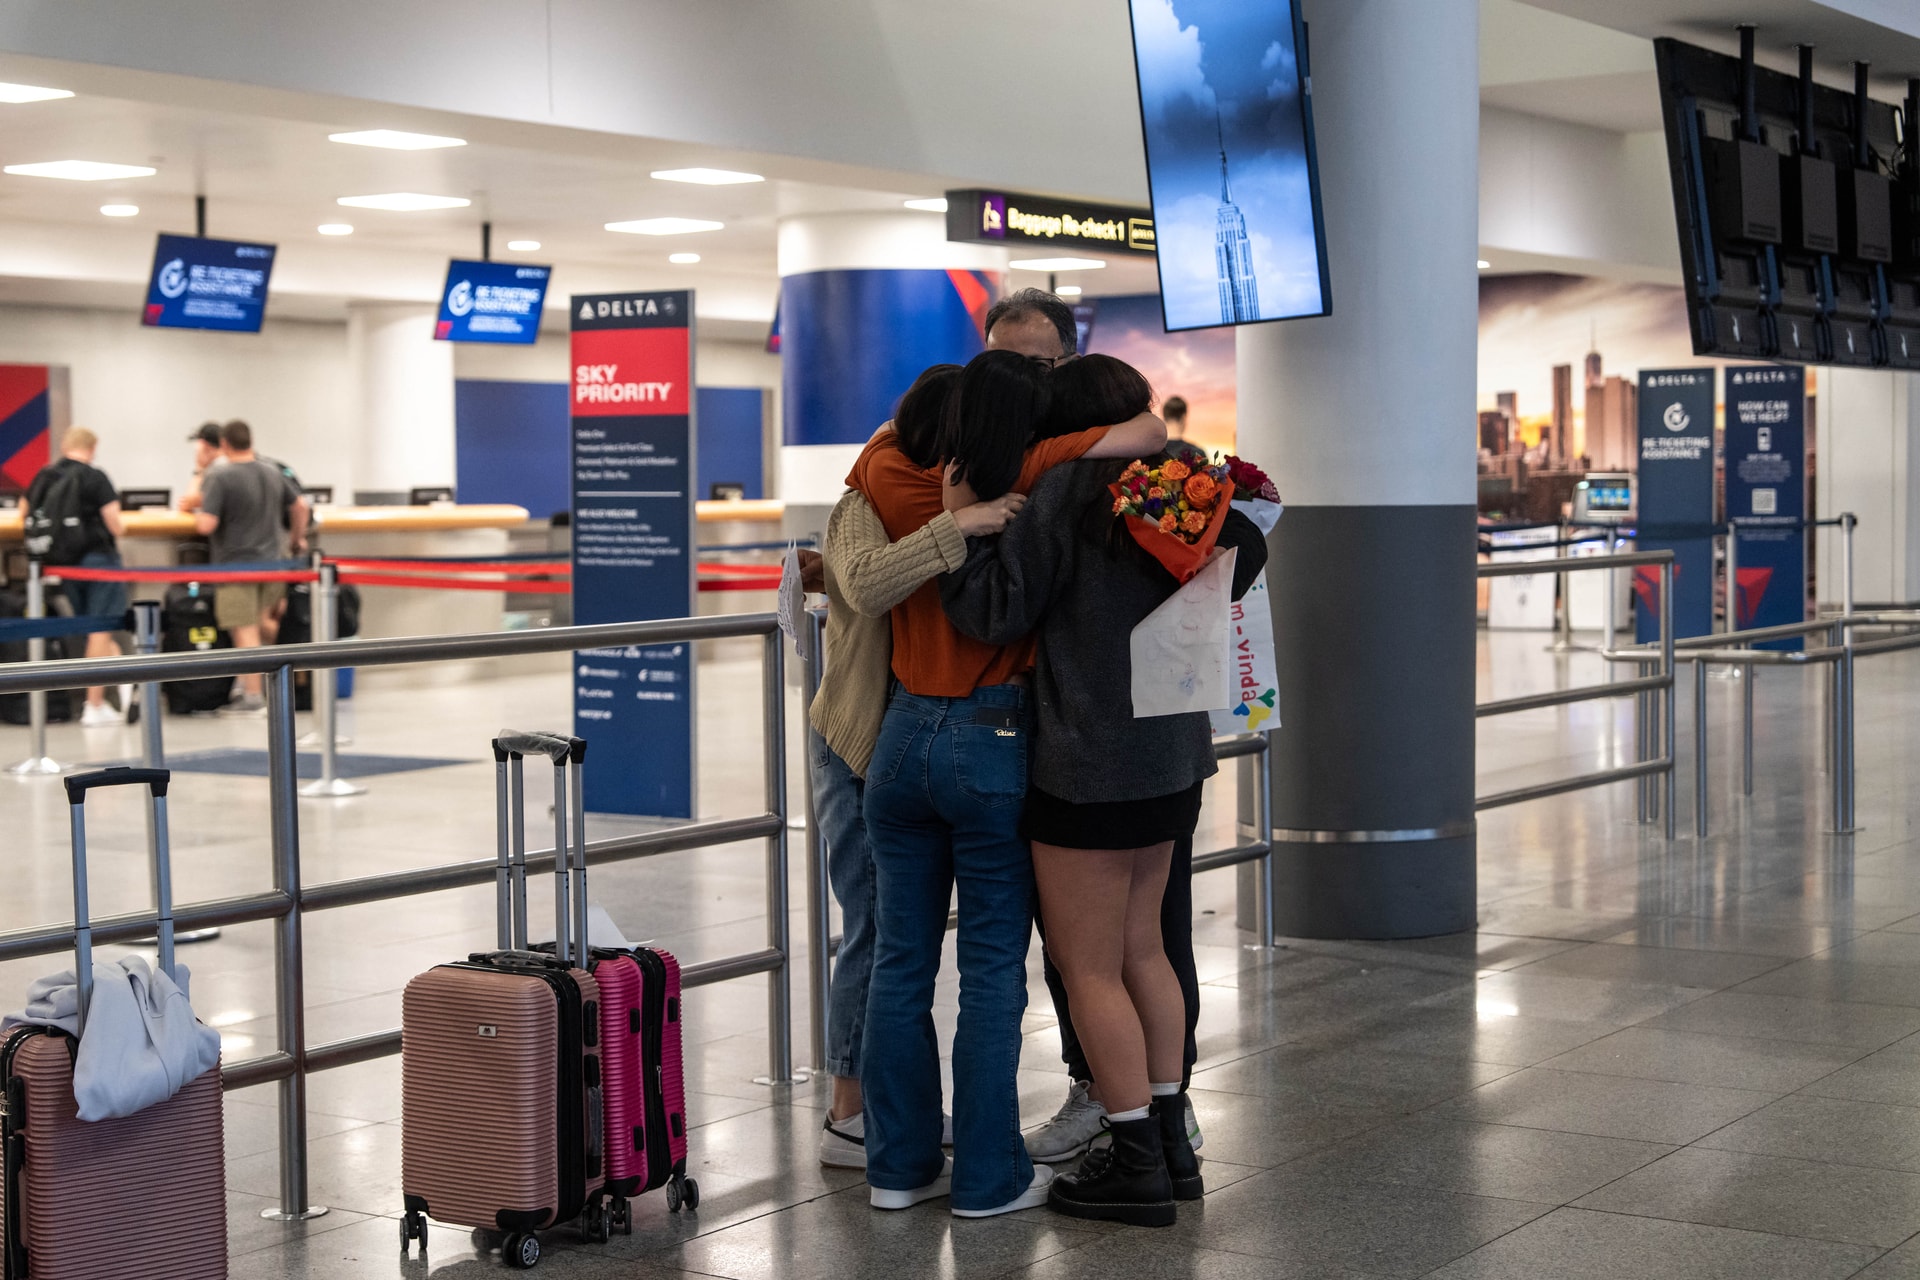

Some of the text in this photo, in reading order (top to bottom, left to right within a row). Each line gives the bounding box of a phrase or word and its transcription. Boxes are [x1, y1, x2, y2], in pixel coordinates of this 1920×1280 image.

[1008, 207, 1062, 238] Baggage
[1062, 214, 1117, 240] Re-check
[597, 299, 658, 317] DELTA
[576, 363, 618, 385] SKY
[1657, 374, 1696, 387] DELTA
[1744, 372, 1786, 383] DELTA
[576, 382, 674, 403] PRIORITY
[1231, 603, 1260, 702] m-vinda
